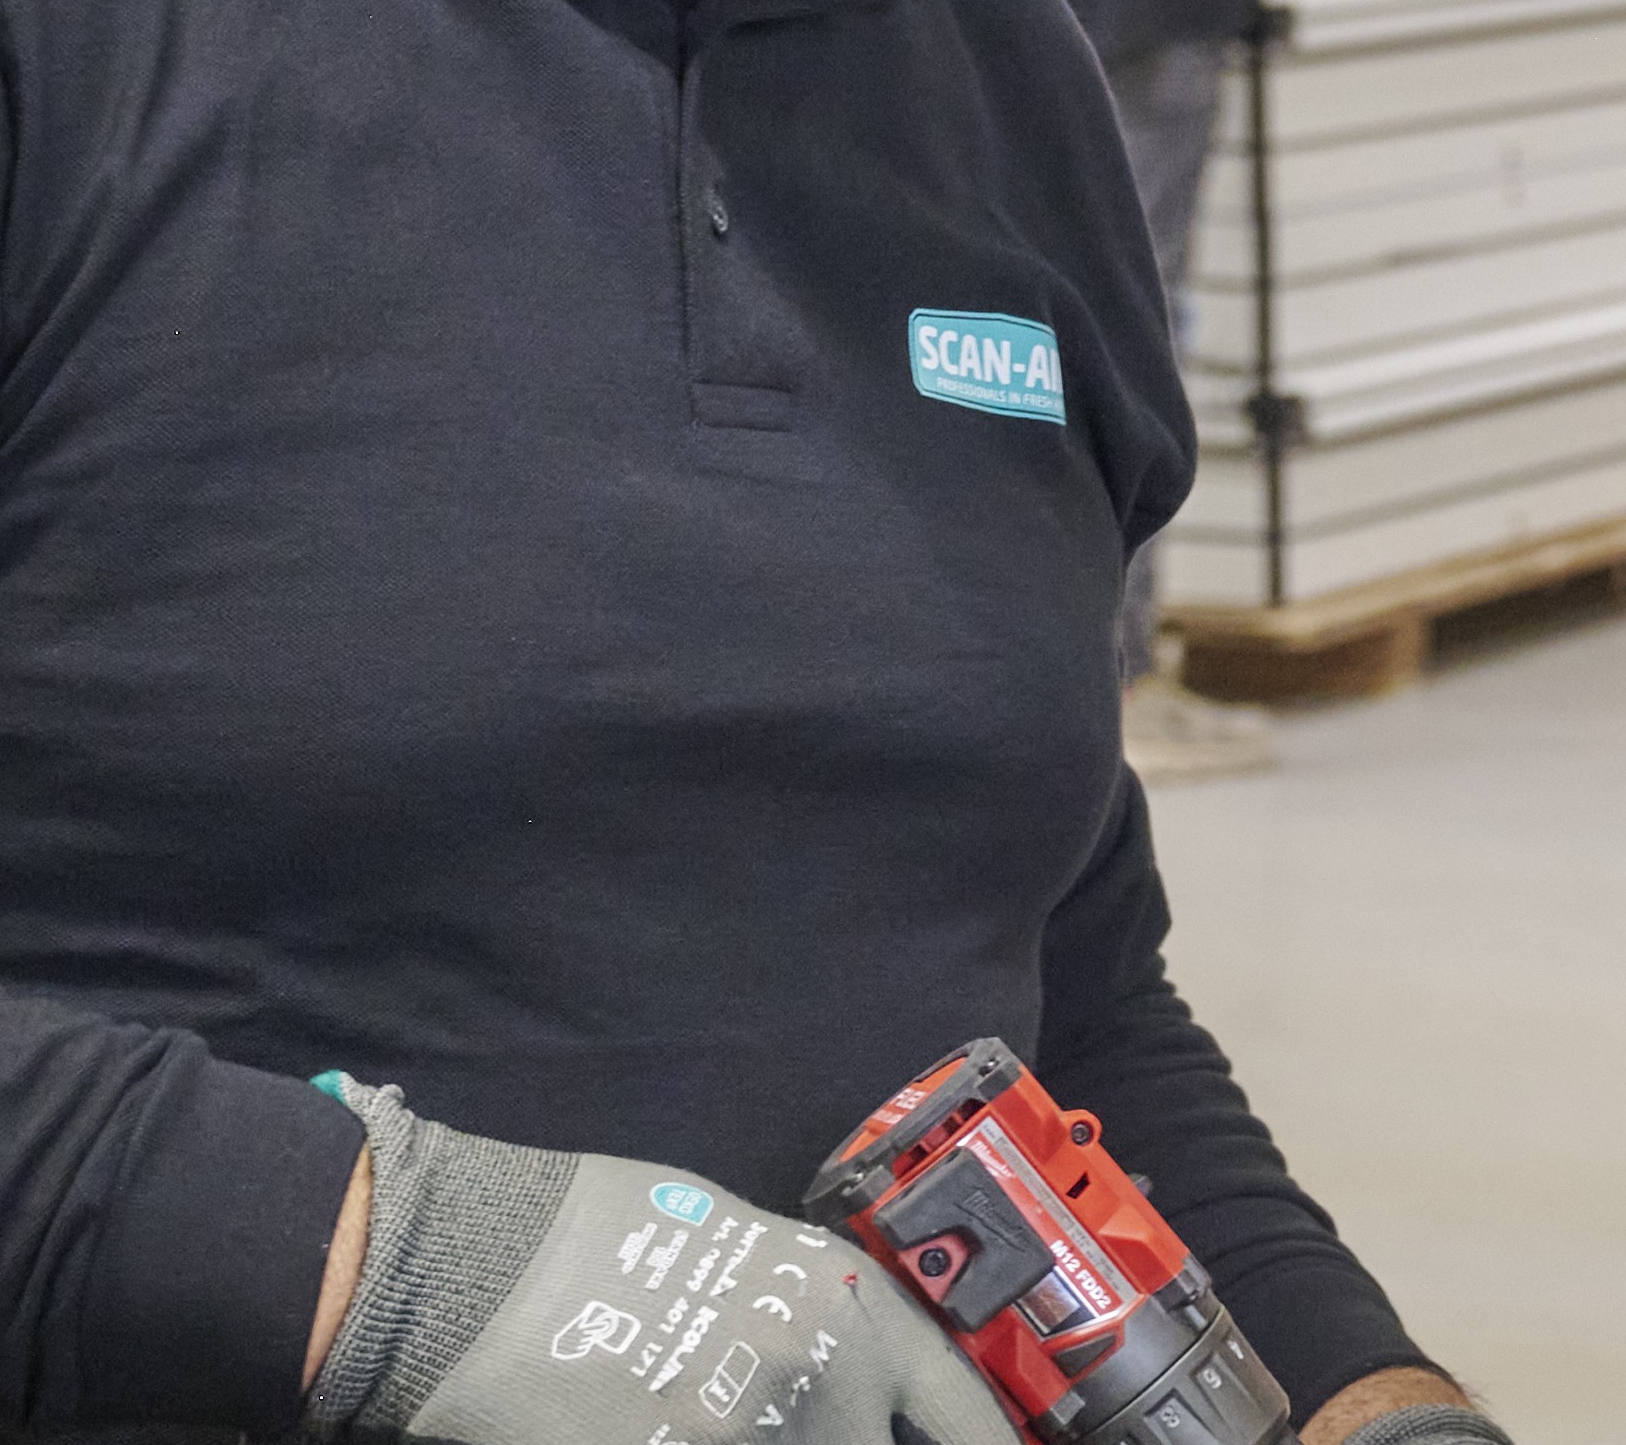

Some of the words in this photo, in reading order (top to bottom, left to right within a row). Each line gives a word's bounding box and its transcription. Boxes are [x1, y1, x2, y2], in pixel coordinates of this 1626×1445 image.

[686, 1247, 722, 1293] 0899
[1049, 1238, 1080, 1274] M12
[1074, 1269, 1113, 1311] FDD2
[658, 1296, 690, 1335] 401
[629, 1341, 664, 1378] 171
[1159, 1405, 1181, 1428] 8
